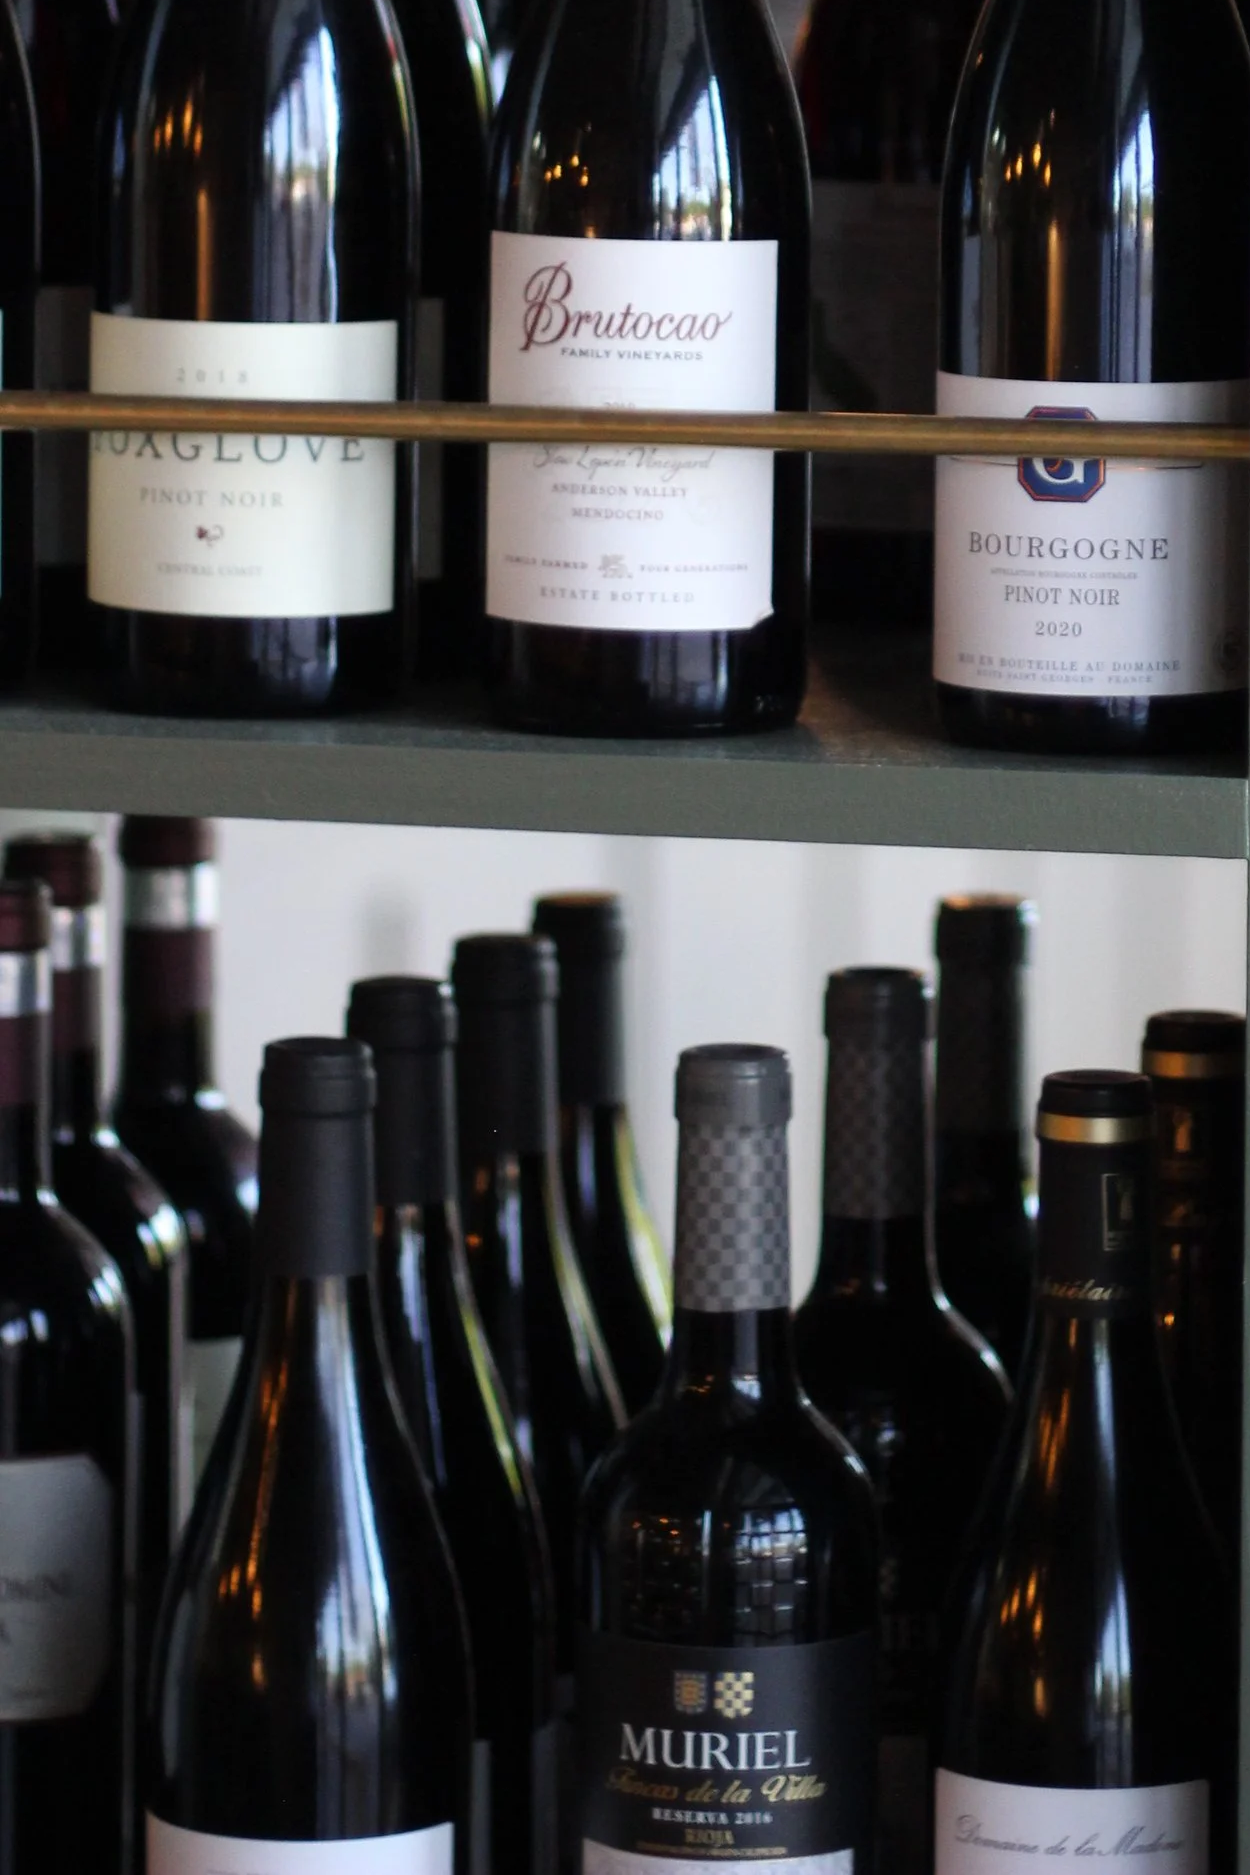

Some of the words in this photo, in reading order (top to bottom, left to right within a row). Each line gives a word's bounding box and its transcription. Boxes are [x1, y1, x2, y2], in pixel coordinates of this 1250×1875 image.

[520, 261, 732, 351] Brutocao
[561, 348, 612, 359] FAMILY
[618, 350, 704, 361] VINEYARDS
[140, 487, 208, 507] PINOT
[221, 491, 284, 508] NOIR
[552, 483, 628, 497] ANDERSON
[634, 486, 688, 498] VALLEY
[572, 507, 665, 521] MENDOCINO
[969, 531, 1169, 561] BOURGOGNE
[540, 586, 600, 602] ESTATE
[610, 590, 695, 604] BOTTLED
[1004, 585, 1062, 605] PINOT
[1069, 588, 1120, 606] NOIR
[1035, 621, 1083, 637] 2020
[1000, 655, 1077, 671] BOUTEILLE
[1085, 660, 1105, 671] AU
[1112, 660, 1181, 671] DOMAINE
[620, 1723, 811, 1770] MURIEL
[686, 1779, 719, 1802] de
[720, 1780, 752, 1803] la
[653, 1807, 729, 1825] RESERVA
[1044, 1835, 1067, 1857] de
[1074, 1833, 1102, 1857] la
